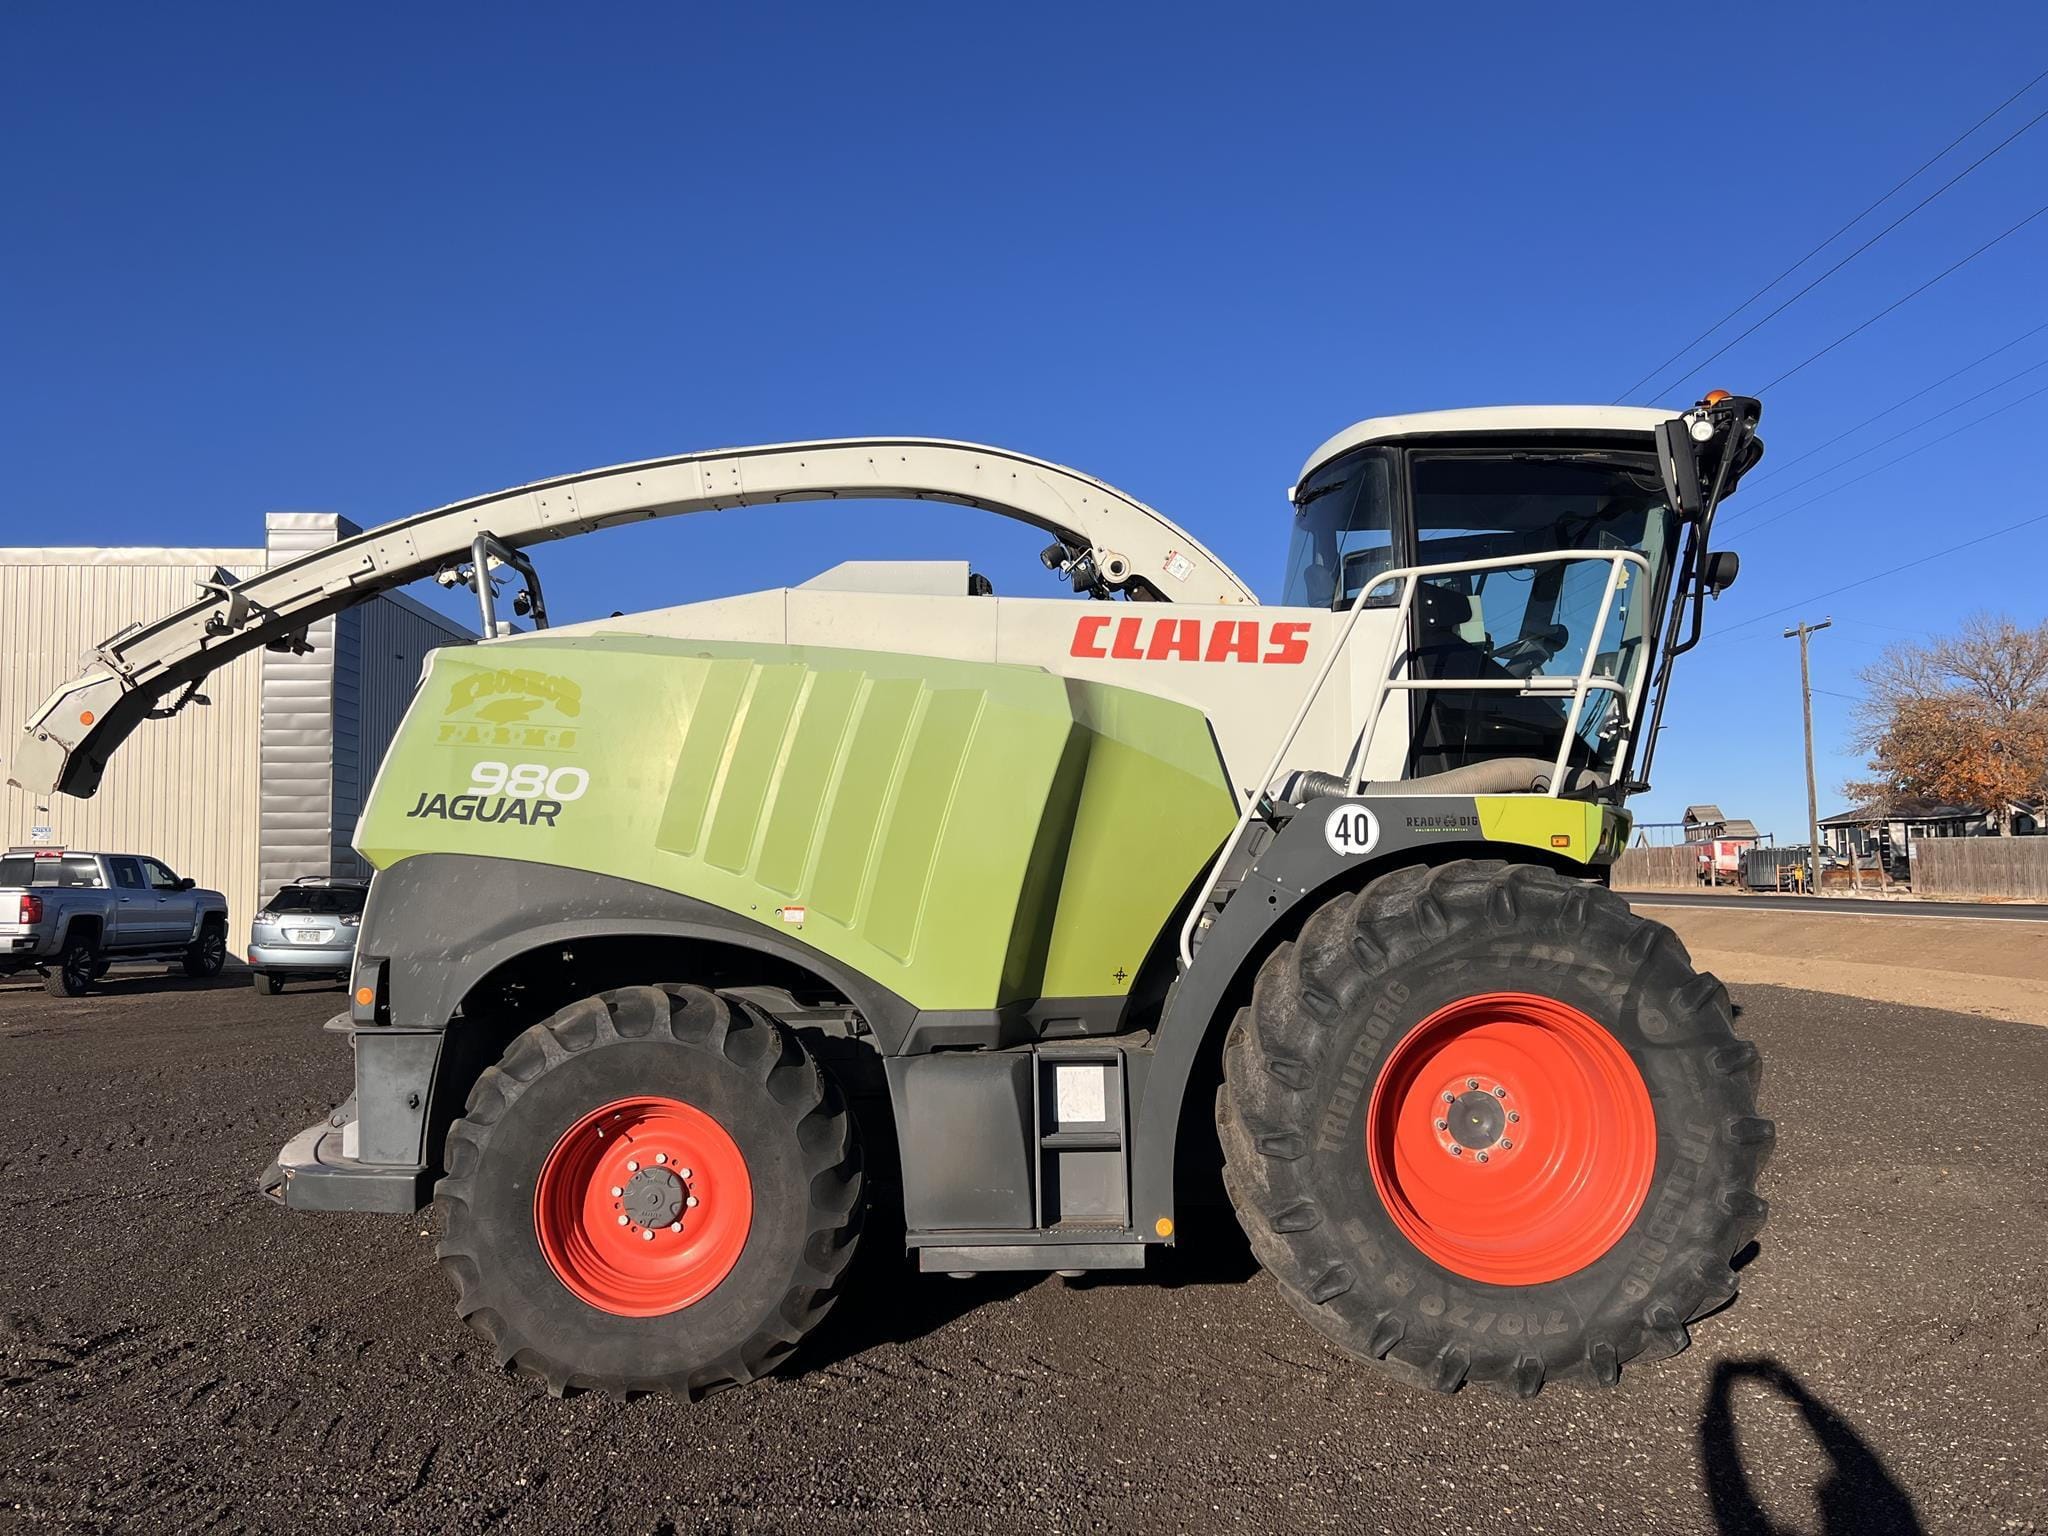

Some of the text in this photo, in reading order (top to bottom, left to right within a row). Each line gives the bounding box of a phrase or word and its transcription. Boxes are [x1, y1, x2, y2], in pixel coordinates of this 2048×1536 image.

[1070, 616, 1312, 664] CLAAS
[466, 761, 590, 801] 980
[407, 792, 562, 827] JAGUAR
[1334, 813, 1369, 846] 40
[1406, 816, 1478, 827] READY DIG
[1315, 980, 1411, 1154] TRELLEBORG
[1621, 1121, 1716, 1300] TRELLEBORG
